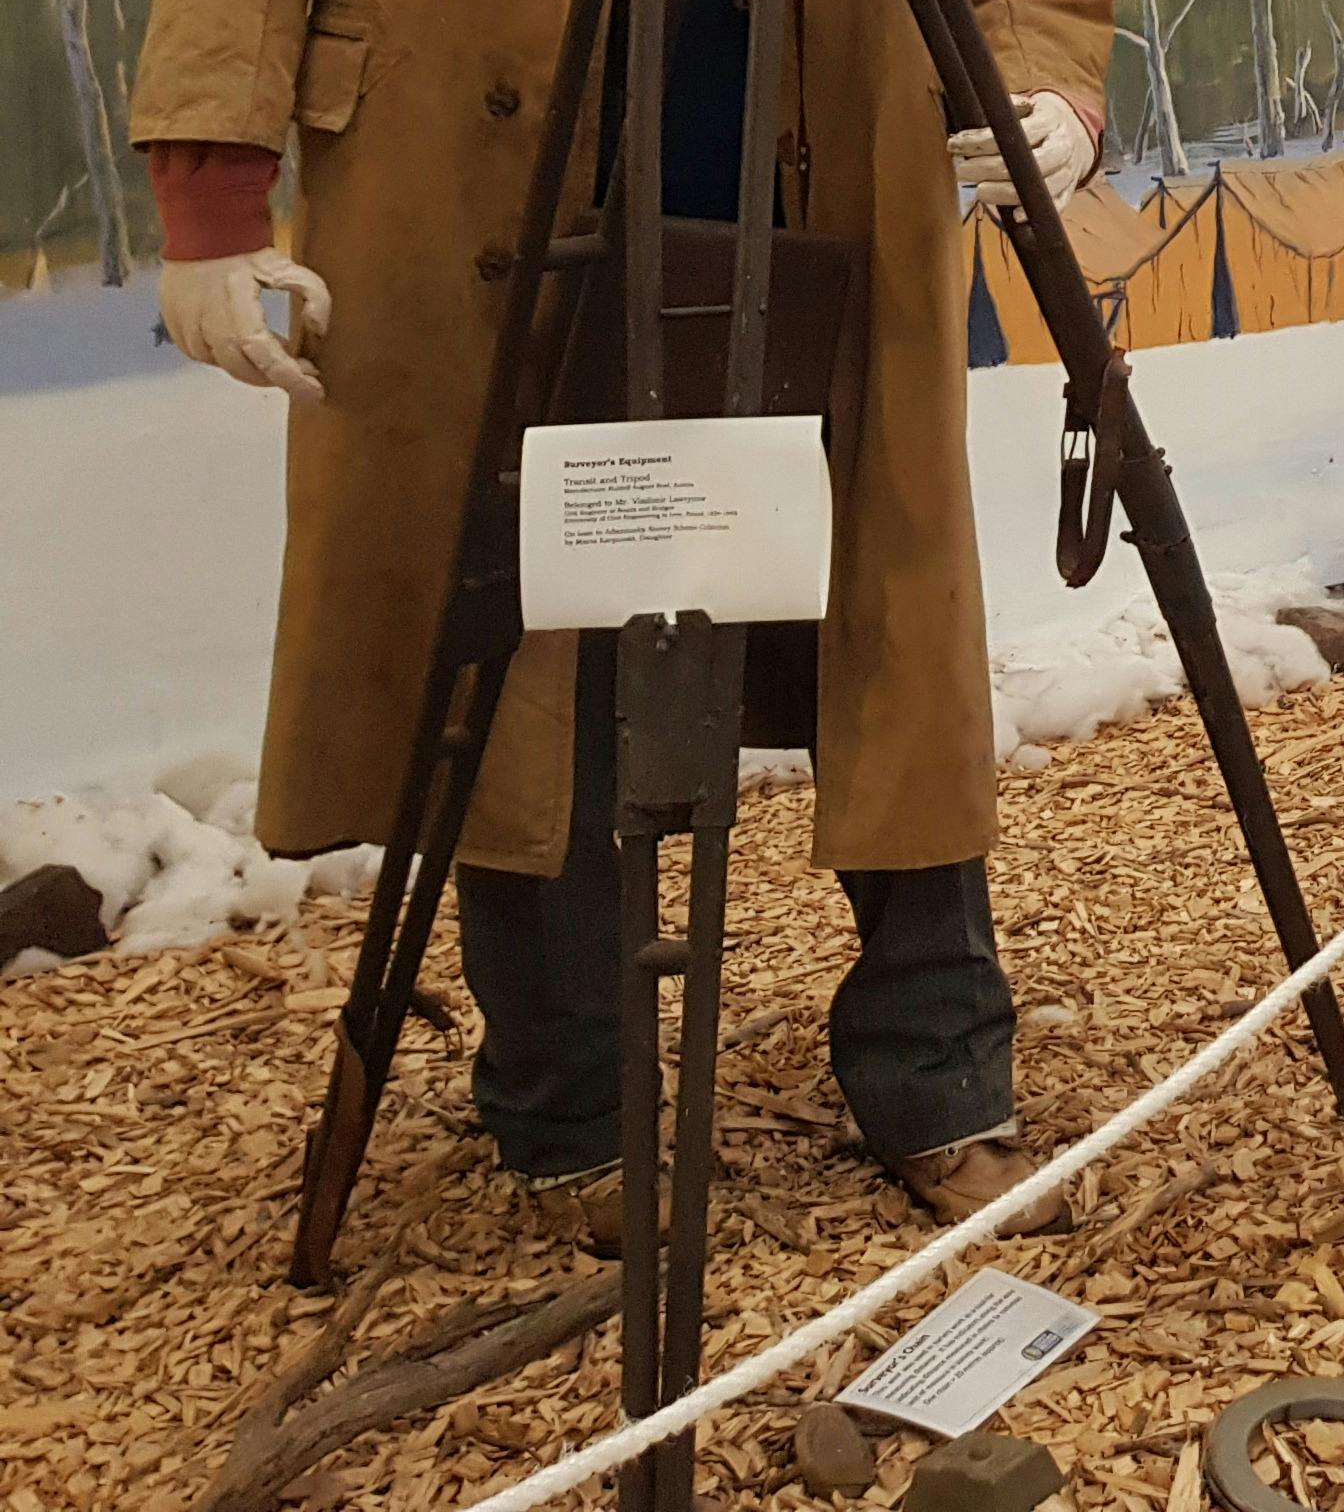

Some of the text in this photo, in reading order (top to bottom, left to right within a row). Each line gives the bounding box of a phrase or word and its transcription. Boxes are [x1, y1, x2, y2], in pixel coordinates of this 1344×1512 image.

[564, 456, 671, 468] Surveyor's Equipment
[563, 477, 596, 486] Transit
[600, 476, 617, 484] and
[620, 473, 650, 487] Tripod
